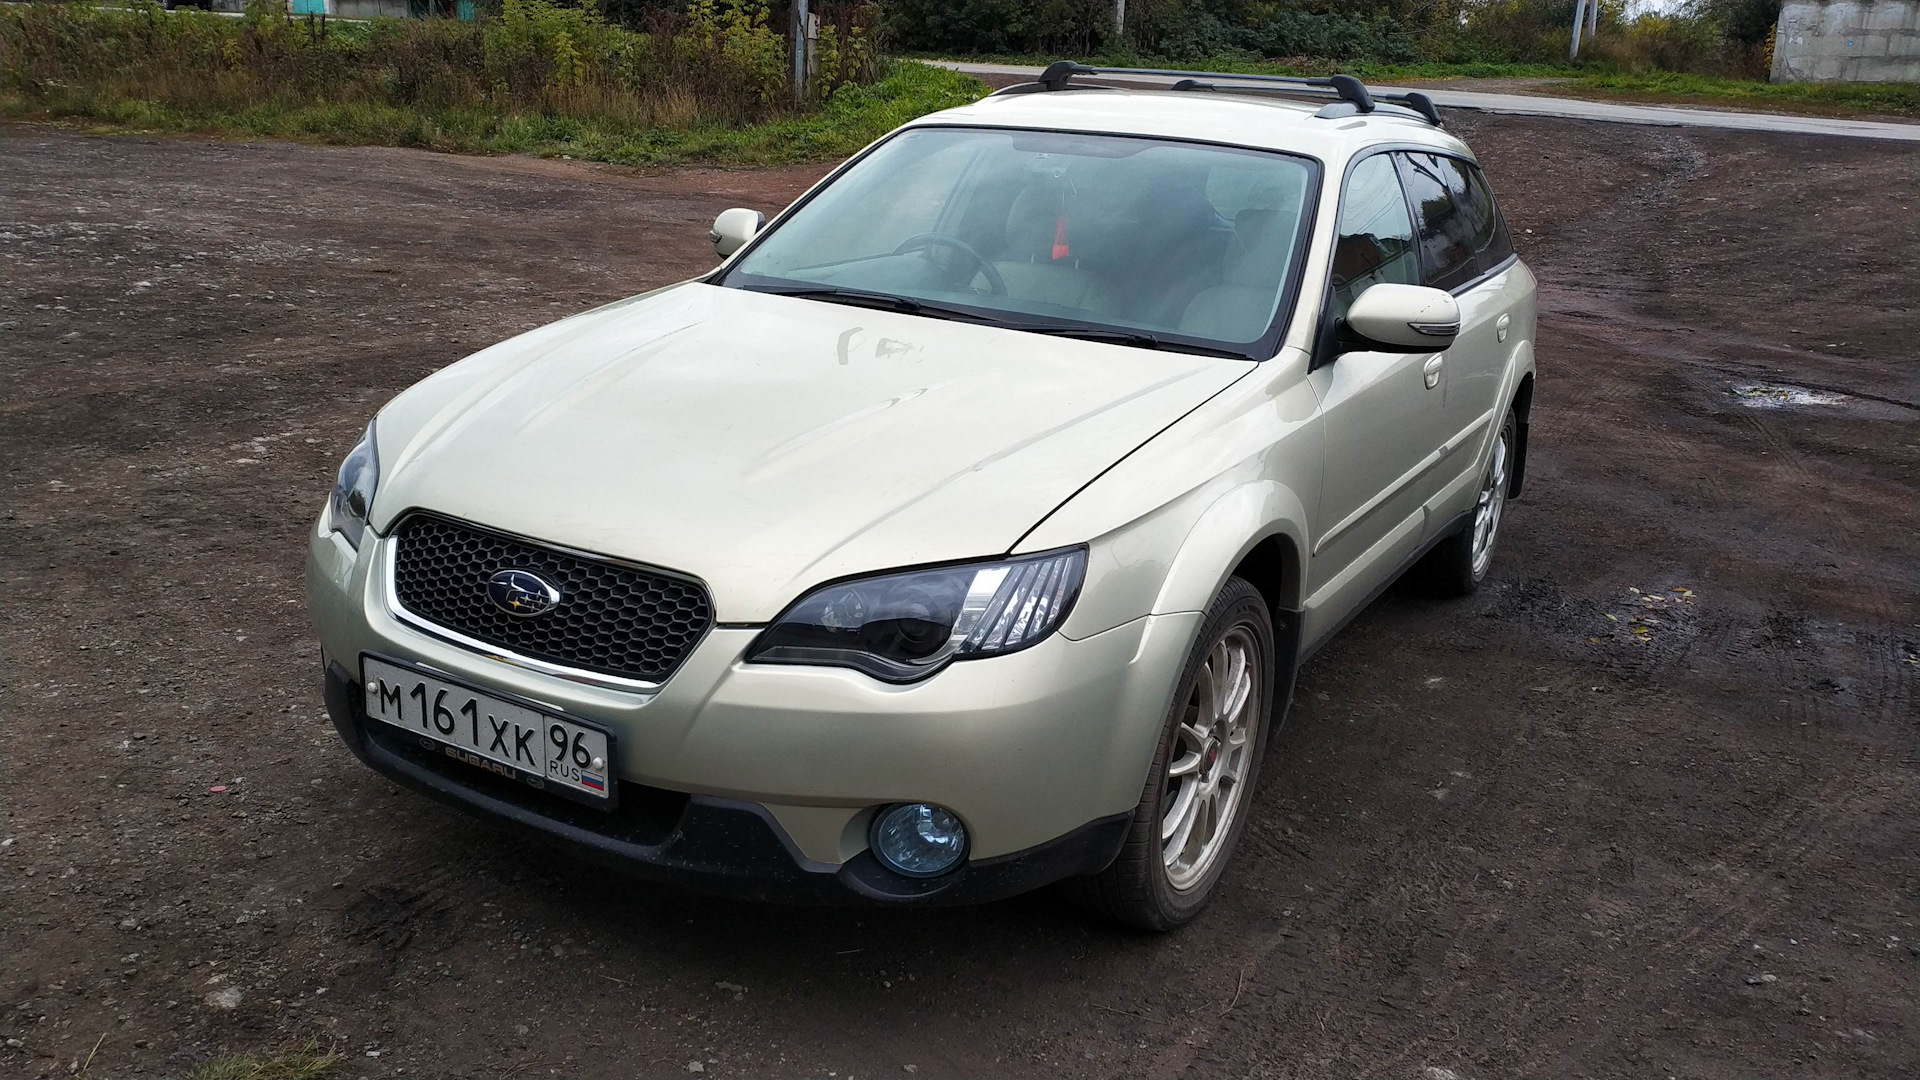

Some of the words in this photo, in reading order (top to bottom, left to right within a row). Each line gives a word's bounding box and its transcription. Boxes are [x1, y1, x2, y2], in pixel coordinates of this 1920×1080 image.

[445, 746, 516, 780] SUBARU
[550, 724, 591, 768] 96
[550, 760, 580, 782] RUS
